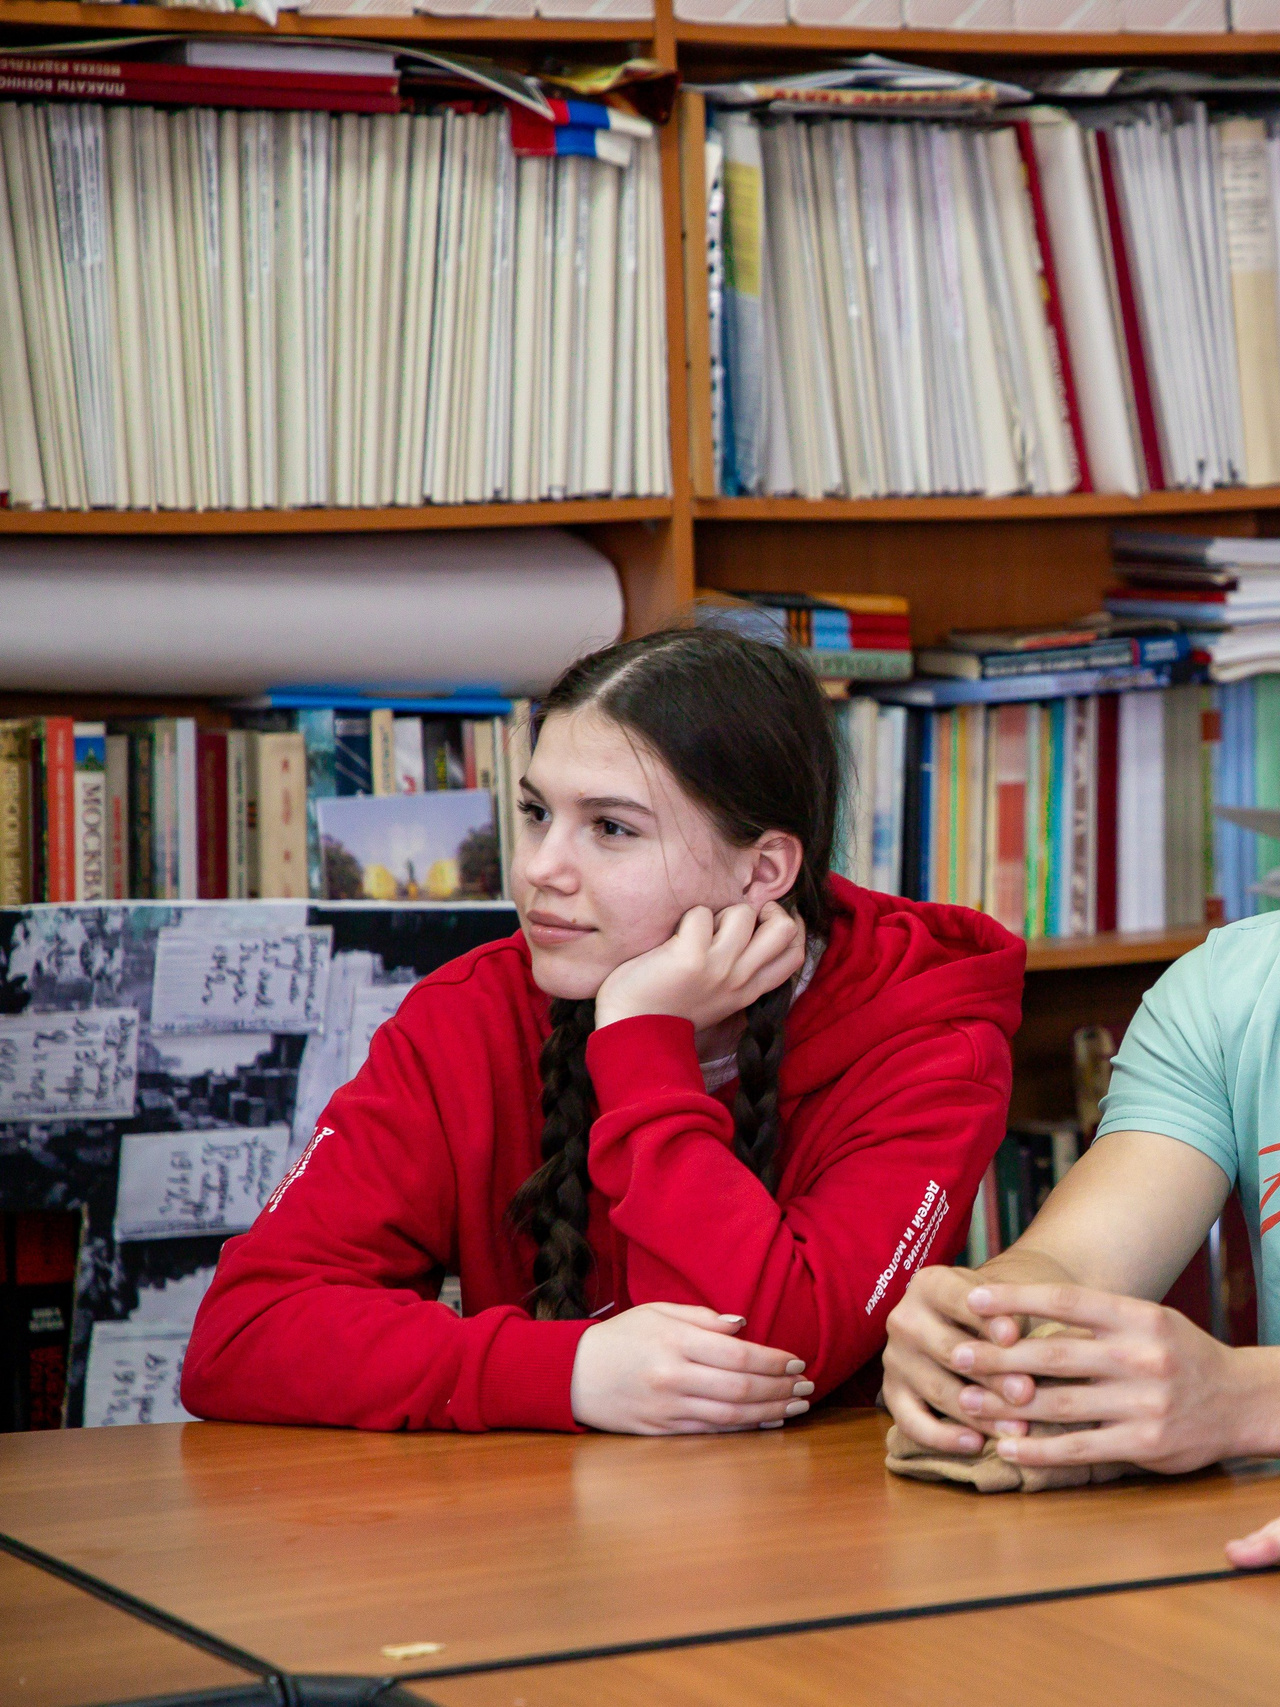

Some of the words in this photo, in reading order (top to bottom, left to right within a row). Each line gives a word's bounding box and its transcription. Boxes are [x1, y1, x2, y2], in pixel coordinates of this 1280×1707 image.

[911, 1180, 940, 1230] детей
[903, 1226, 916, 1242] и
[864, 1239, 908, 1316] молодёжи
